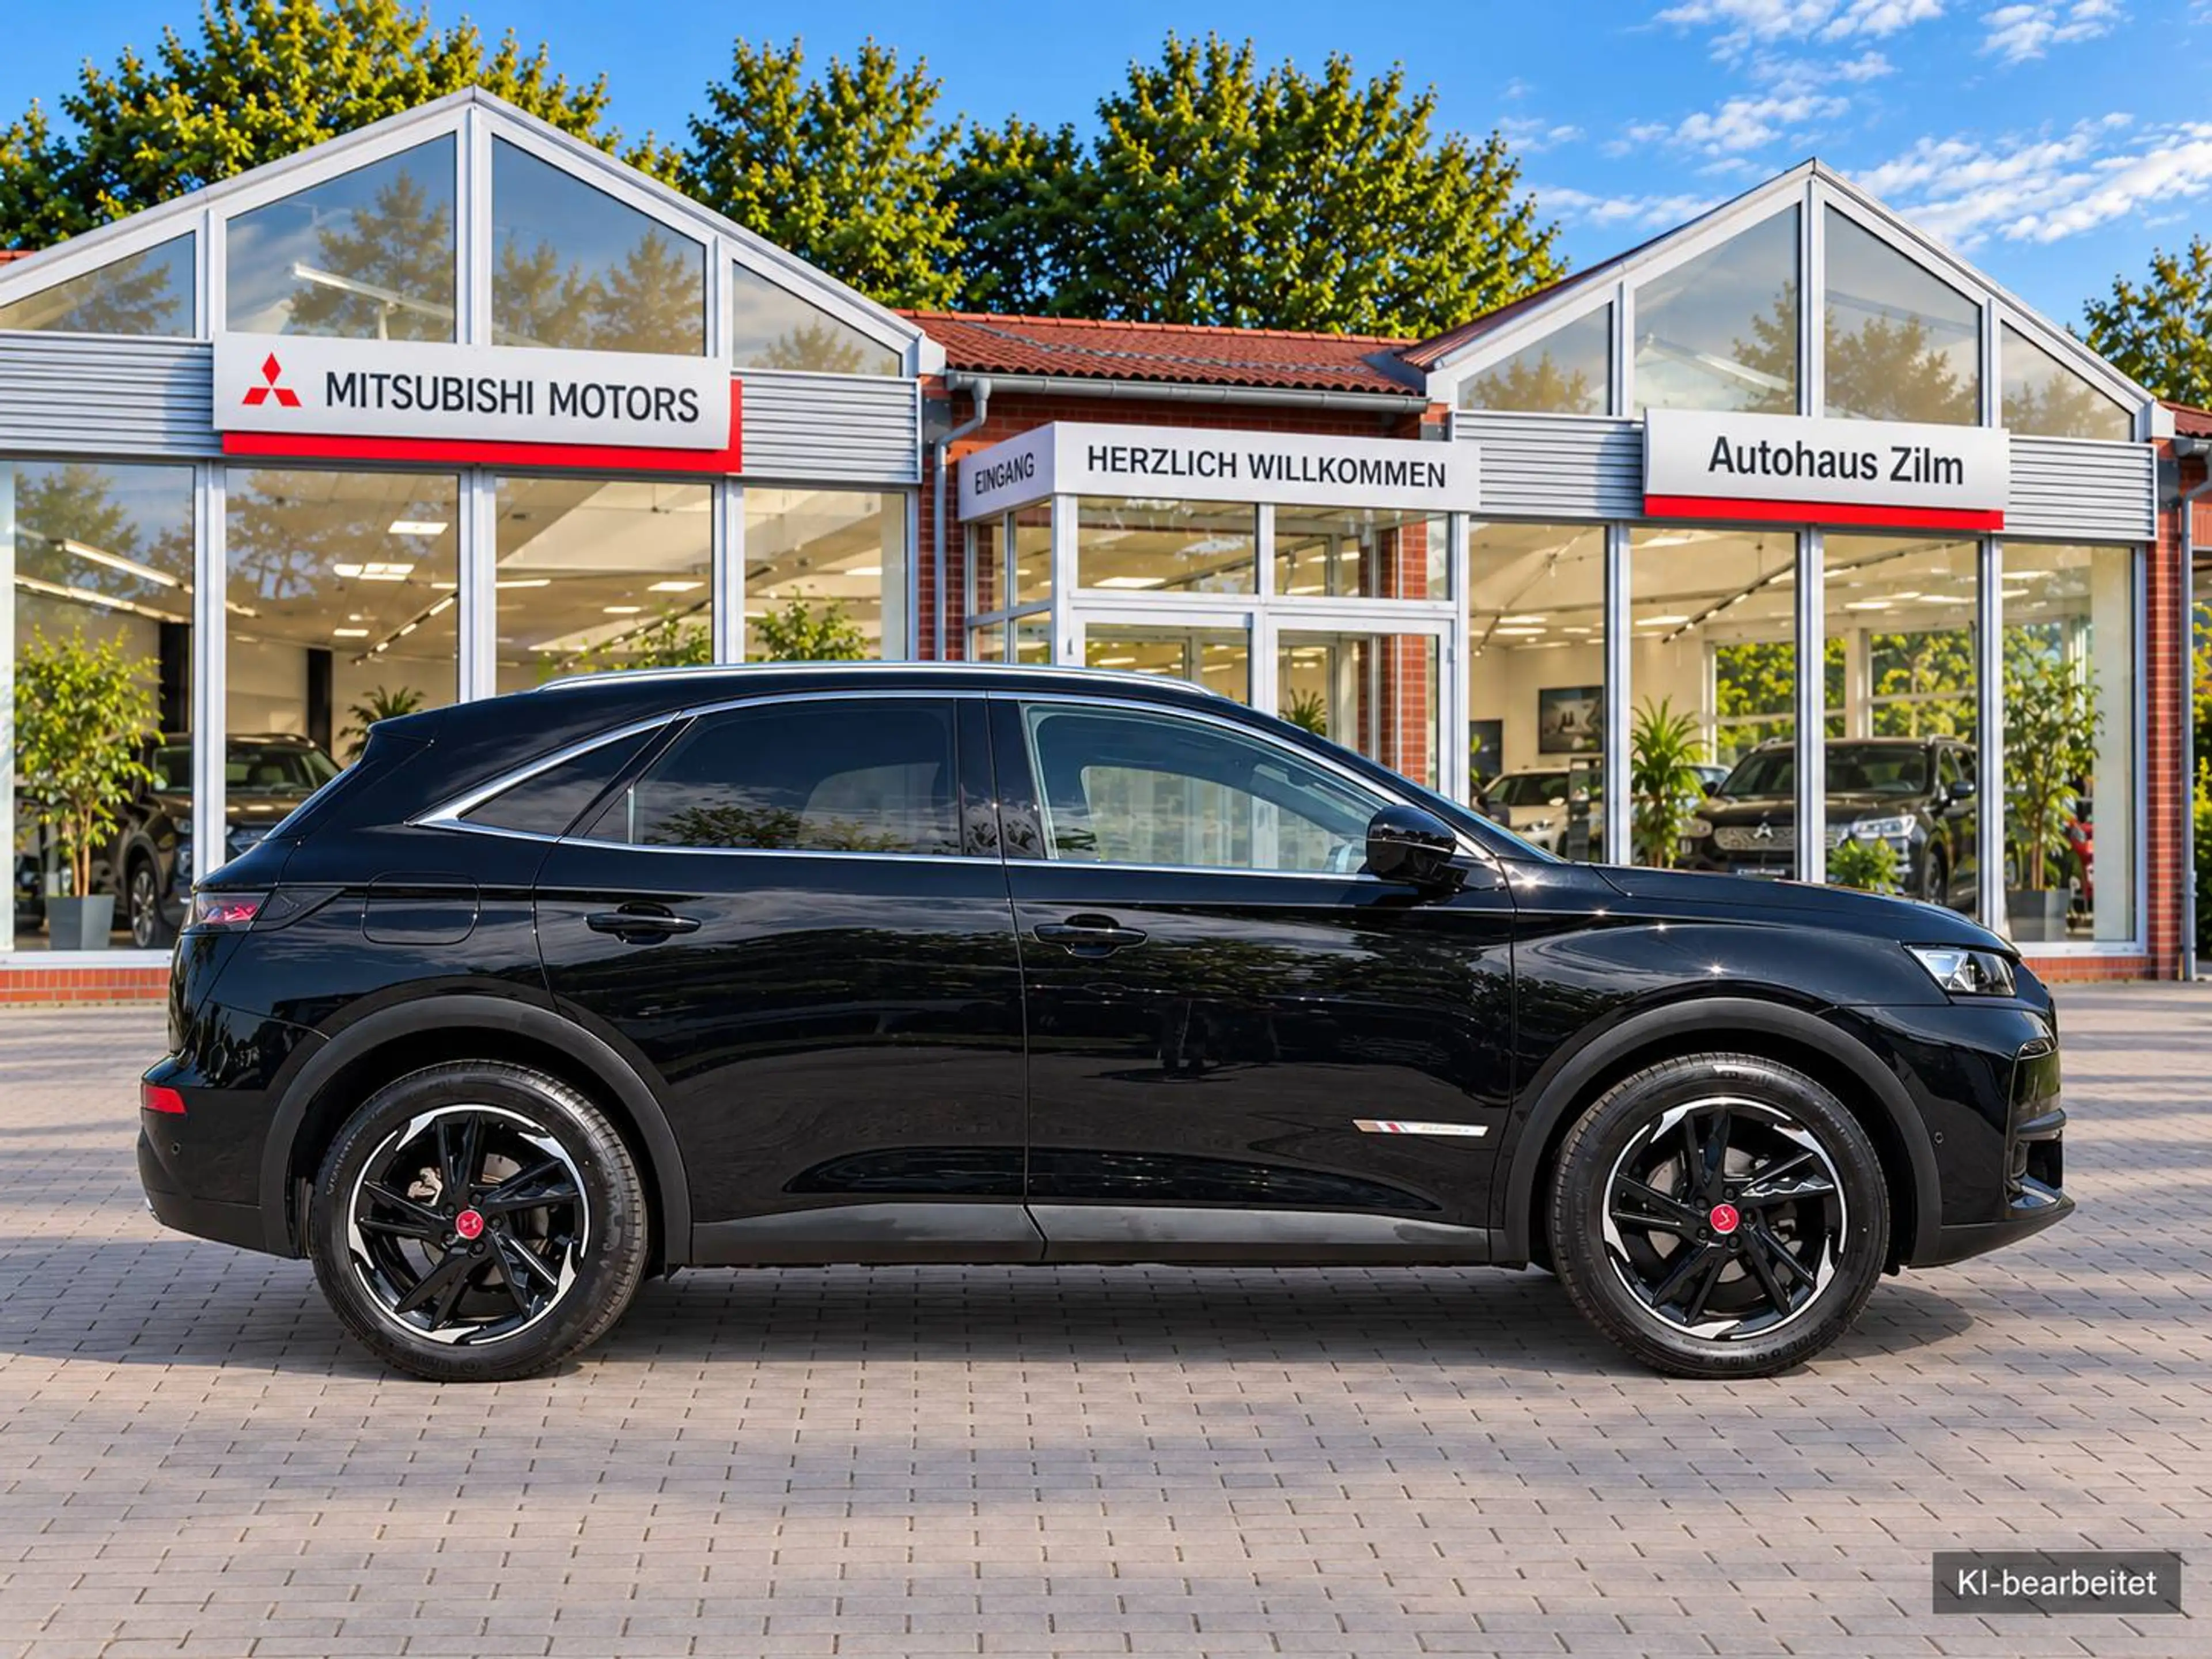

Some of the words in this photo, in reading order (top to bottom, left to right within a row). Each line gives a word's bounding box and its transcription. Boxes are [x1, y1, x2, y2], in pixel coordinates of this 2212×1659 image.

[327, 372, 533, 415] MITSUBISHI
[550, 382, 699, 423] MOTORS
[975, 452, 1035, 496] EINGANG
[1088, 445, 1237, 478] HERZLICH
[1248, 453, 1446, 488] WILLKOMMEN
[1708, 436, 1878, 480] Autohaus
[1890, 446, 1963, 485] Zilm
